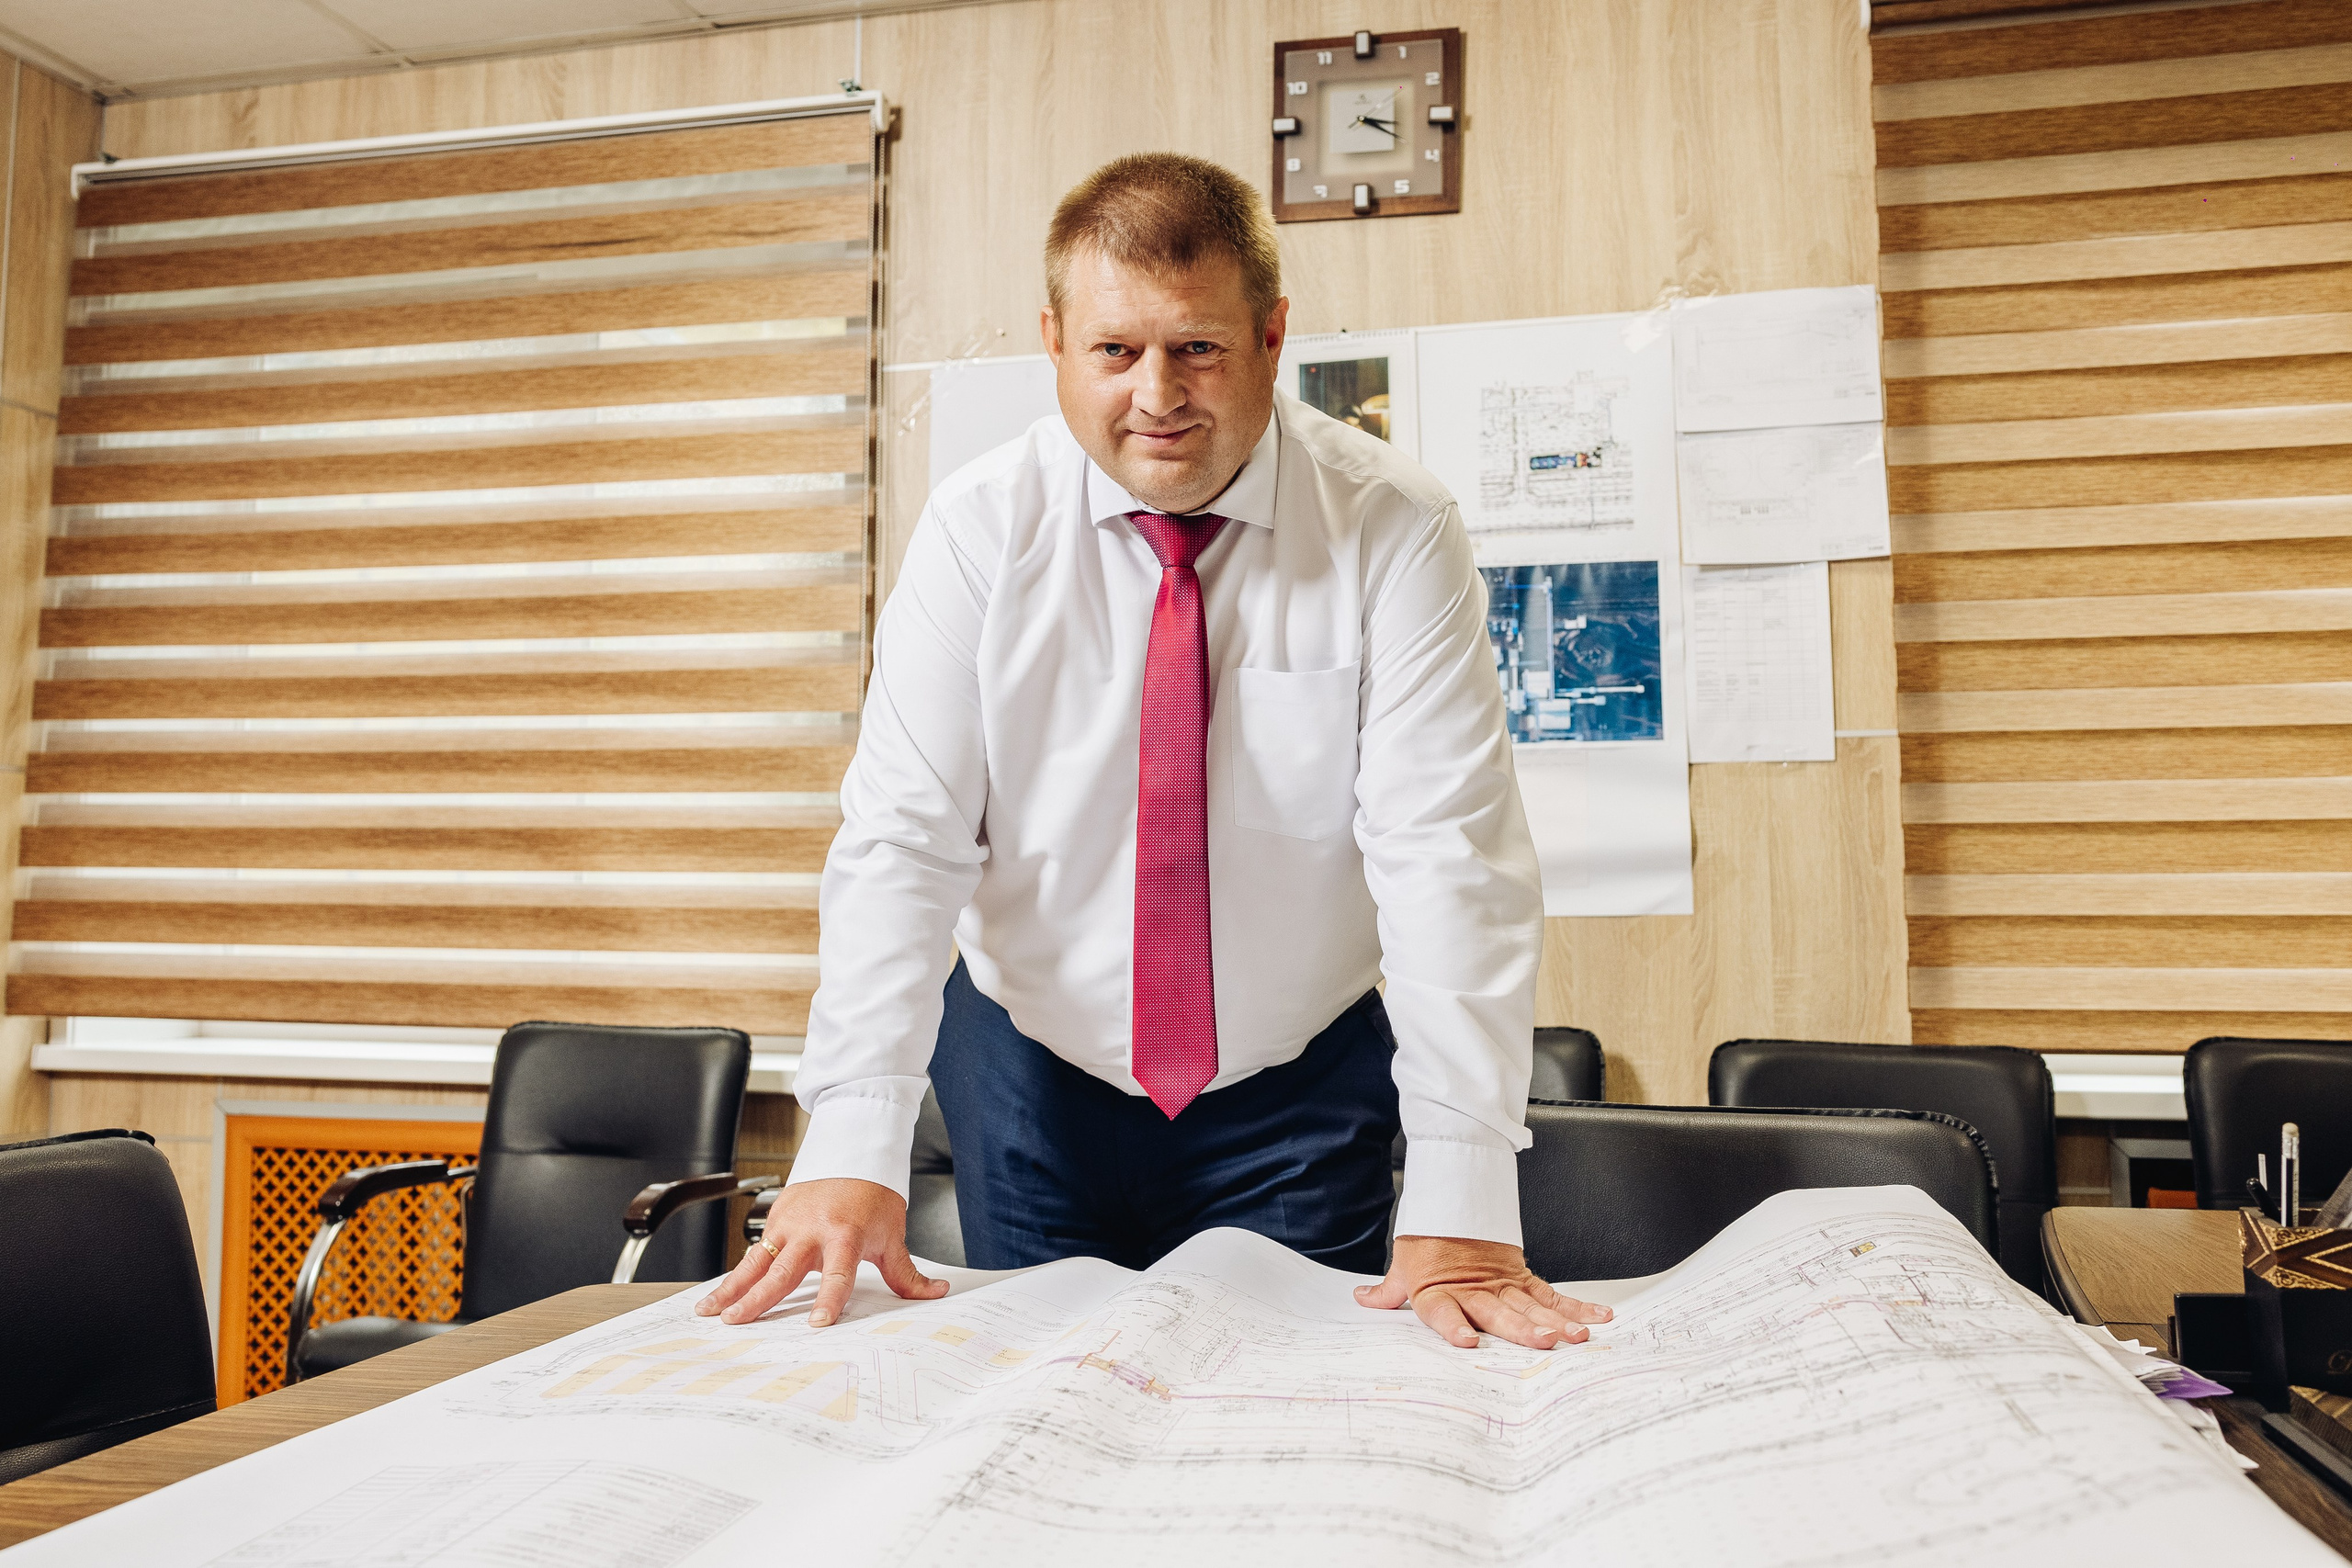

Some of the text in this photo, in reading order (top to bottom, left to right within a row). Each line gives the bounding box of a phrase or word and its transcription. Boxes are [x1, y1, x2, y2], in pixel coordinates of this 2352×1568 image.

[1317, 51, 1332, 65] 11
[1397, 46, 1407, 59] 1
[1425, 72, 1441, 86] 2
[1286, 81, 1307, 96] 10
[1424, 149, 1440, 163] 4
[1286, 158, 1301, 172] 8
[1313, 185, 1328, 198] 7
[1394, 179, 1410, 195] 5
